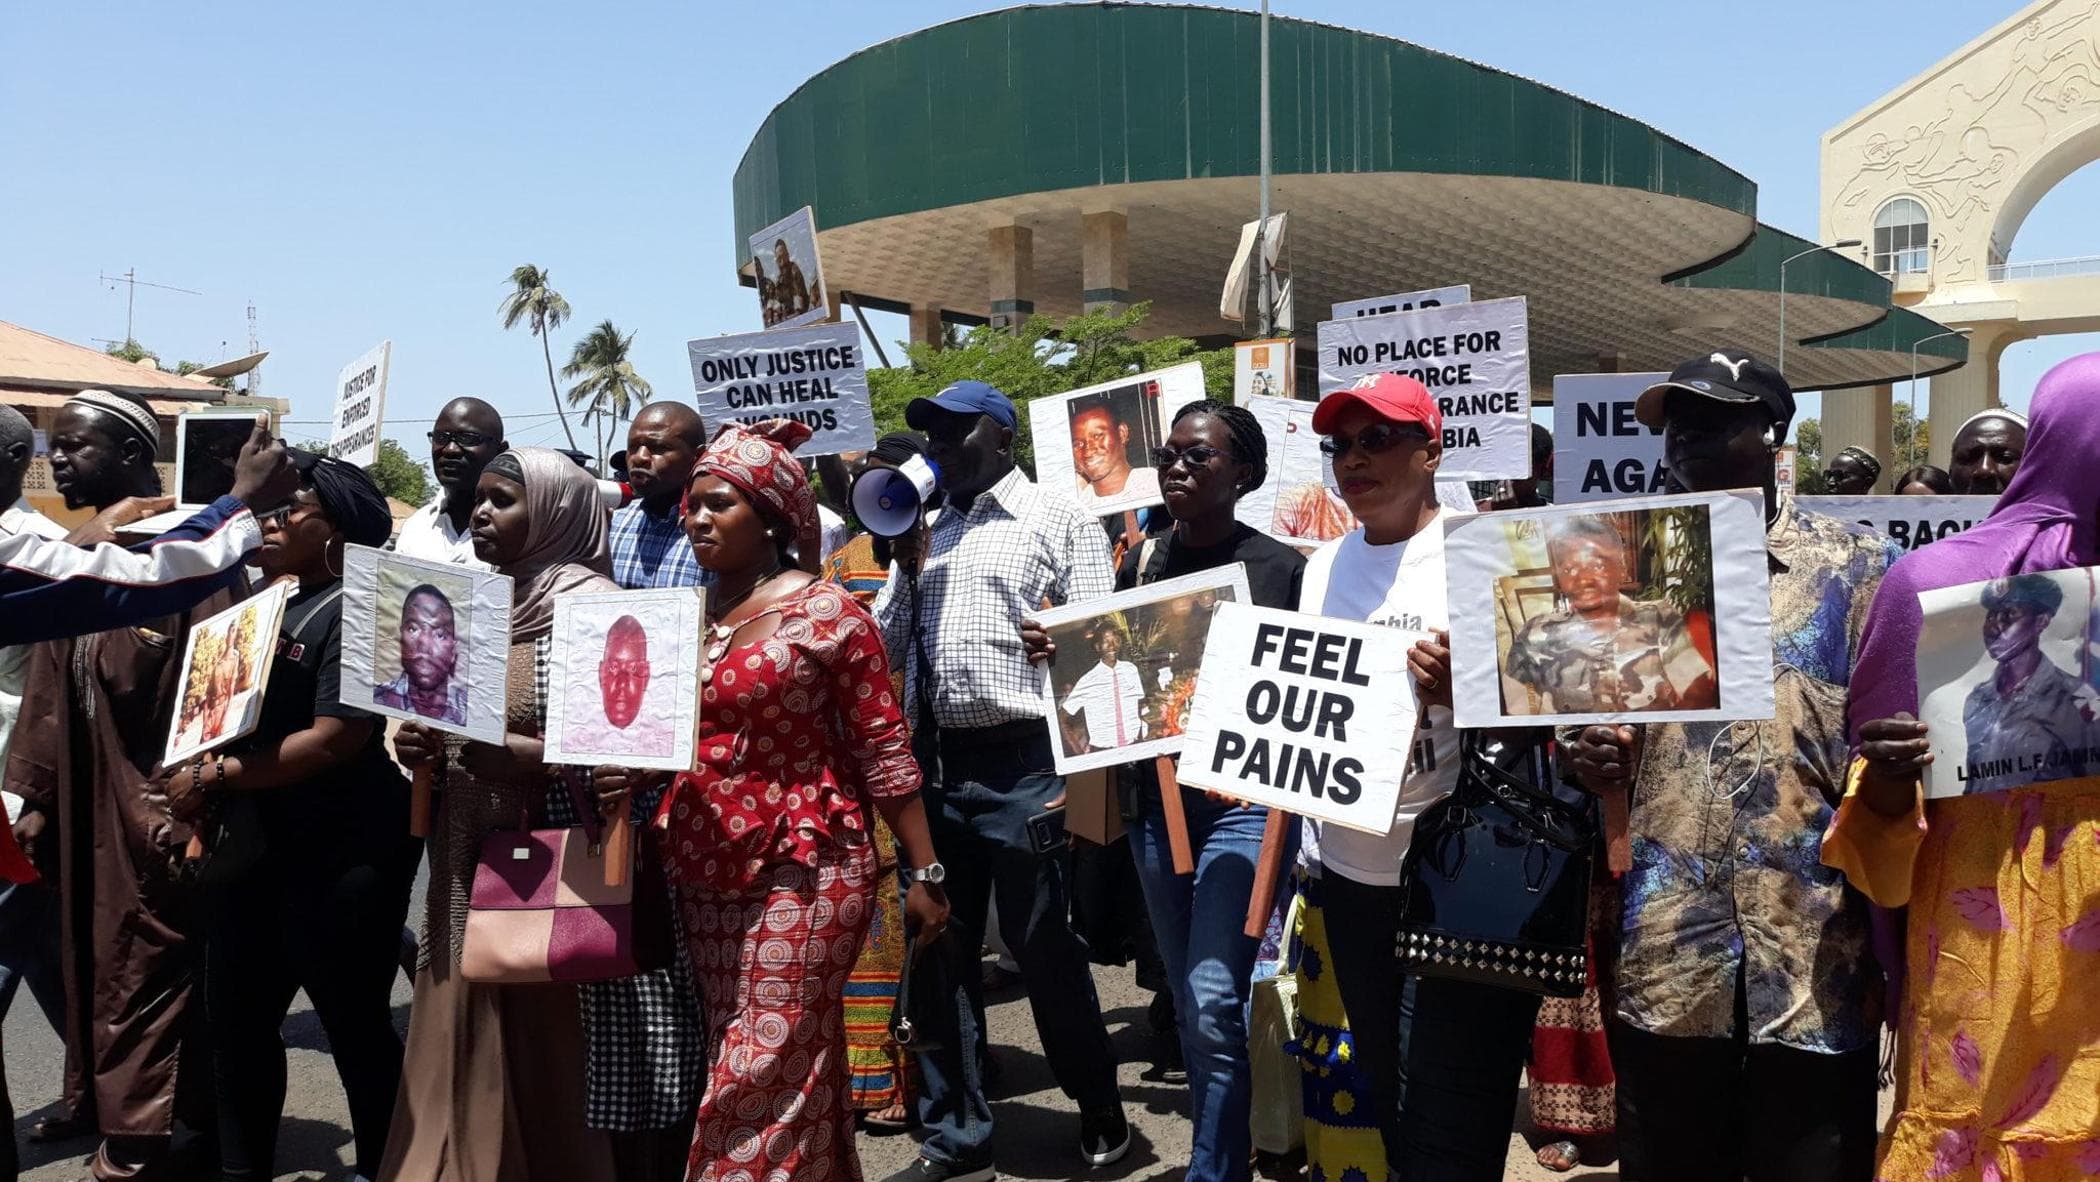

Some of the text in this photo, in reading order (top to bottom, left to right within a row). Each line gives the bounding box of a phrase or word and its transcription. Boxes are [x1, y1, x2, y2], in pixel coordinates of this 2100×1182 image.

[701, 345, 855, 382] ONLY JUSTICE
[1338, 330, 1501, 367] NO PLACE FOR
[342, 364, 376, 401] JUSTICE FOR
[726, 377, 839, 409] CAN HEAL
[341, 395, 371, 429] ENFORCED
[1888, 520, 1984, 551] BAC
[1250, 622, 1370, 687] FEEL
[1245, 679, 1355, 743] OUR
[1210, 729, 1365, 805] PAINS
[1957, 758, 2013, 782] LAMIN
